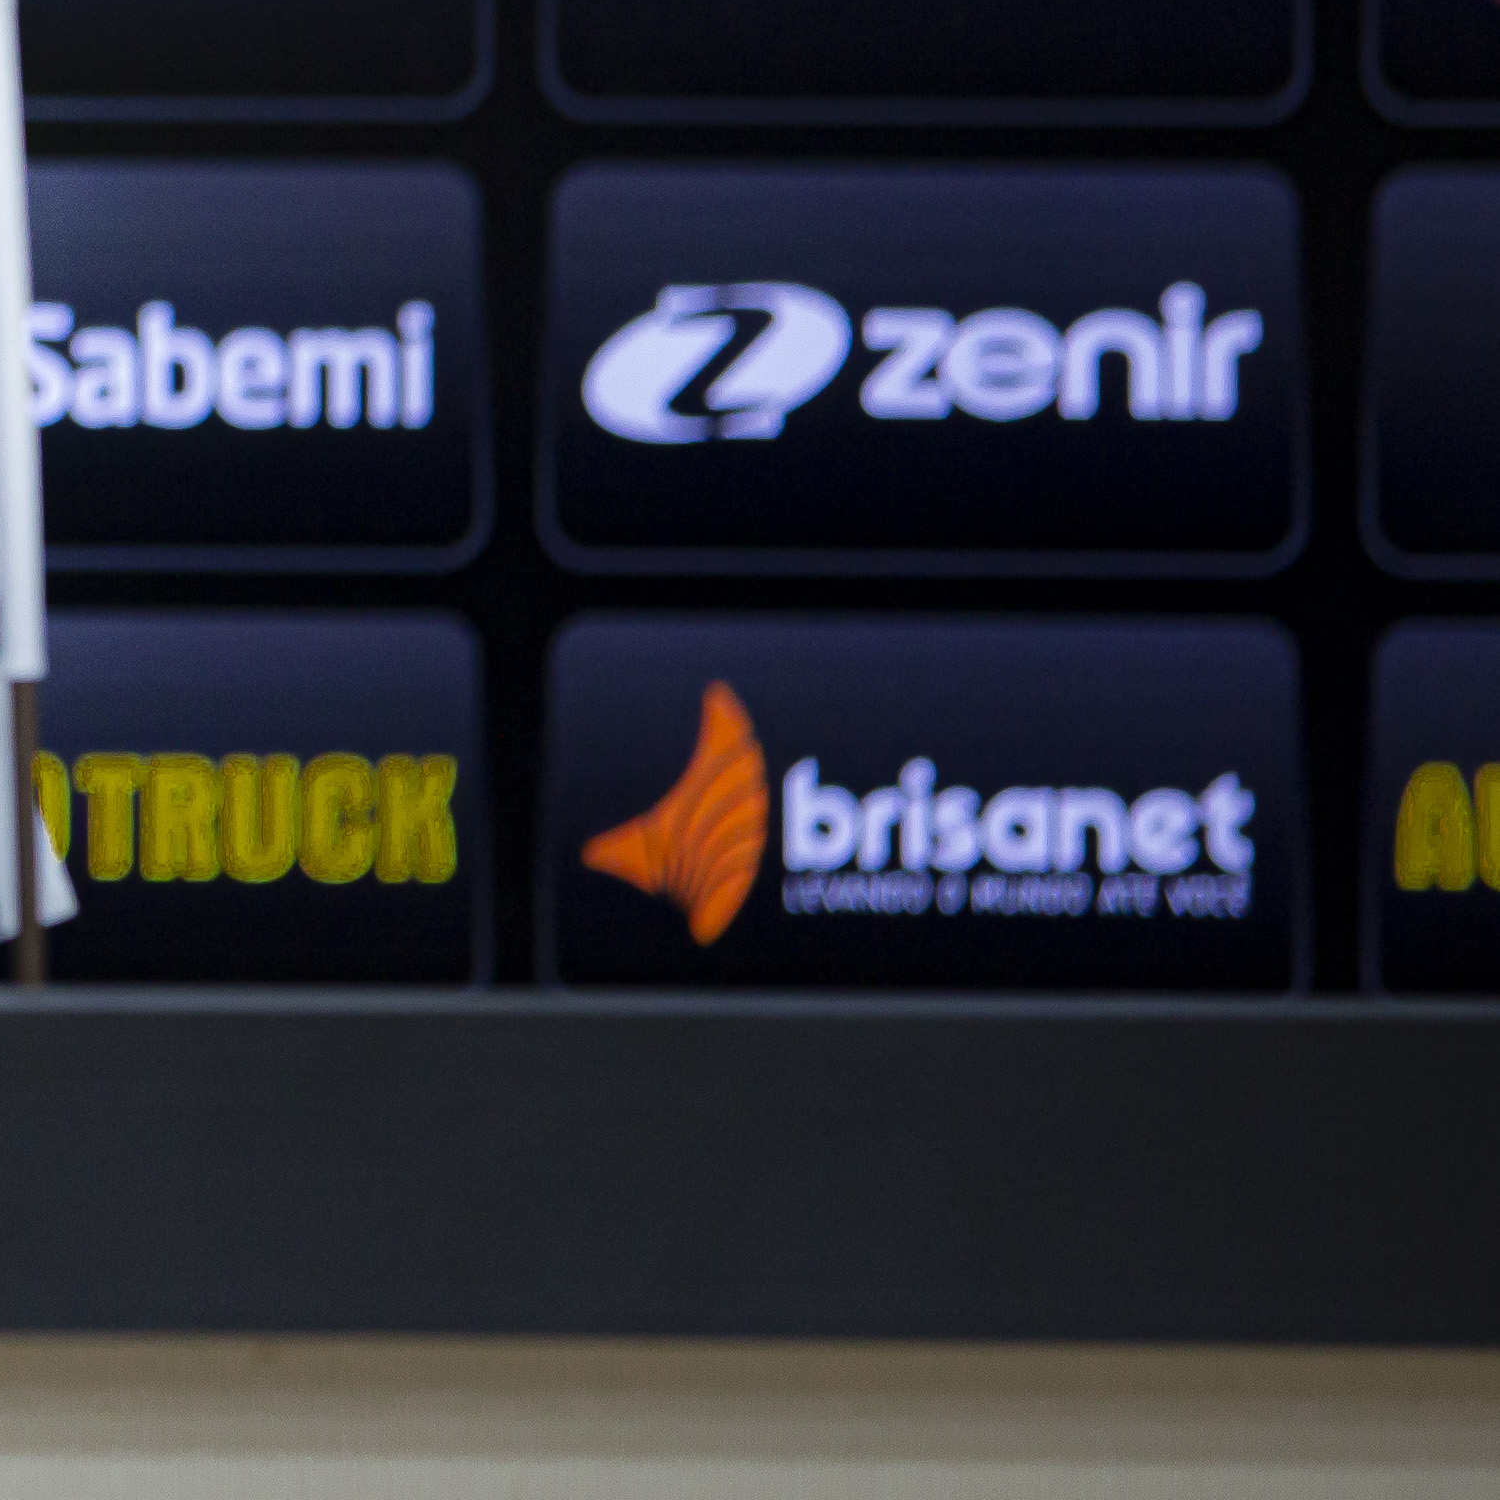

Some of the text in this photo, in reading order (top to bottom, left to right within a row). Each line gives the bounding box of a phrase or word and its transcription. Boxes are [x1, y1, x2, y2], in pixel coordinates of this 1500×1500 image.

[26, 300, 435, 429] Sabemi
[861, 281, 1264, 421] zenir
[782, 757, 1255, 874] brisanet
